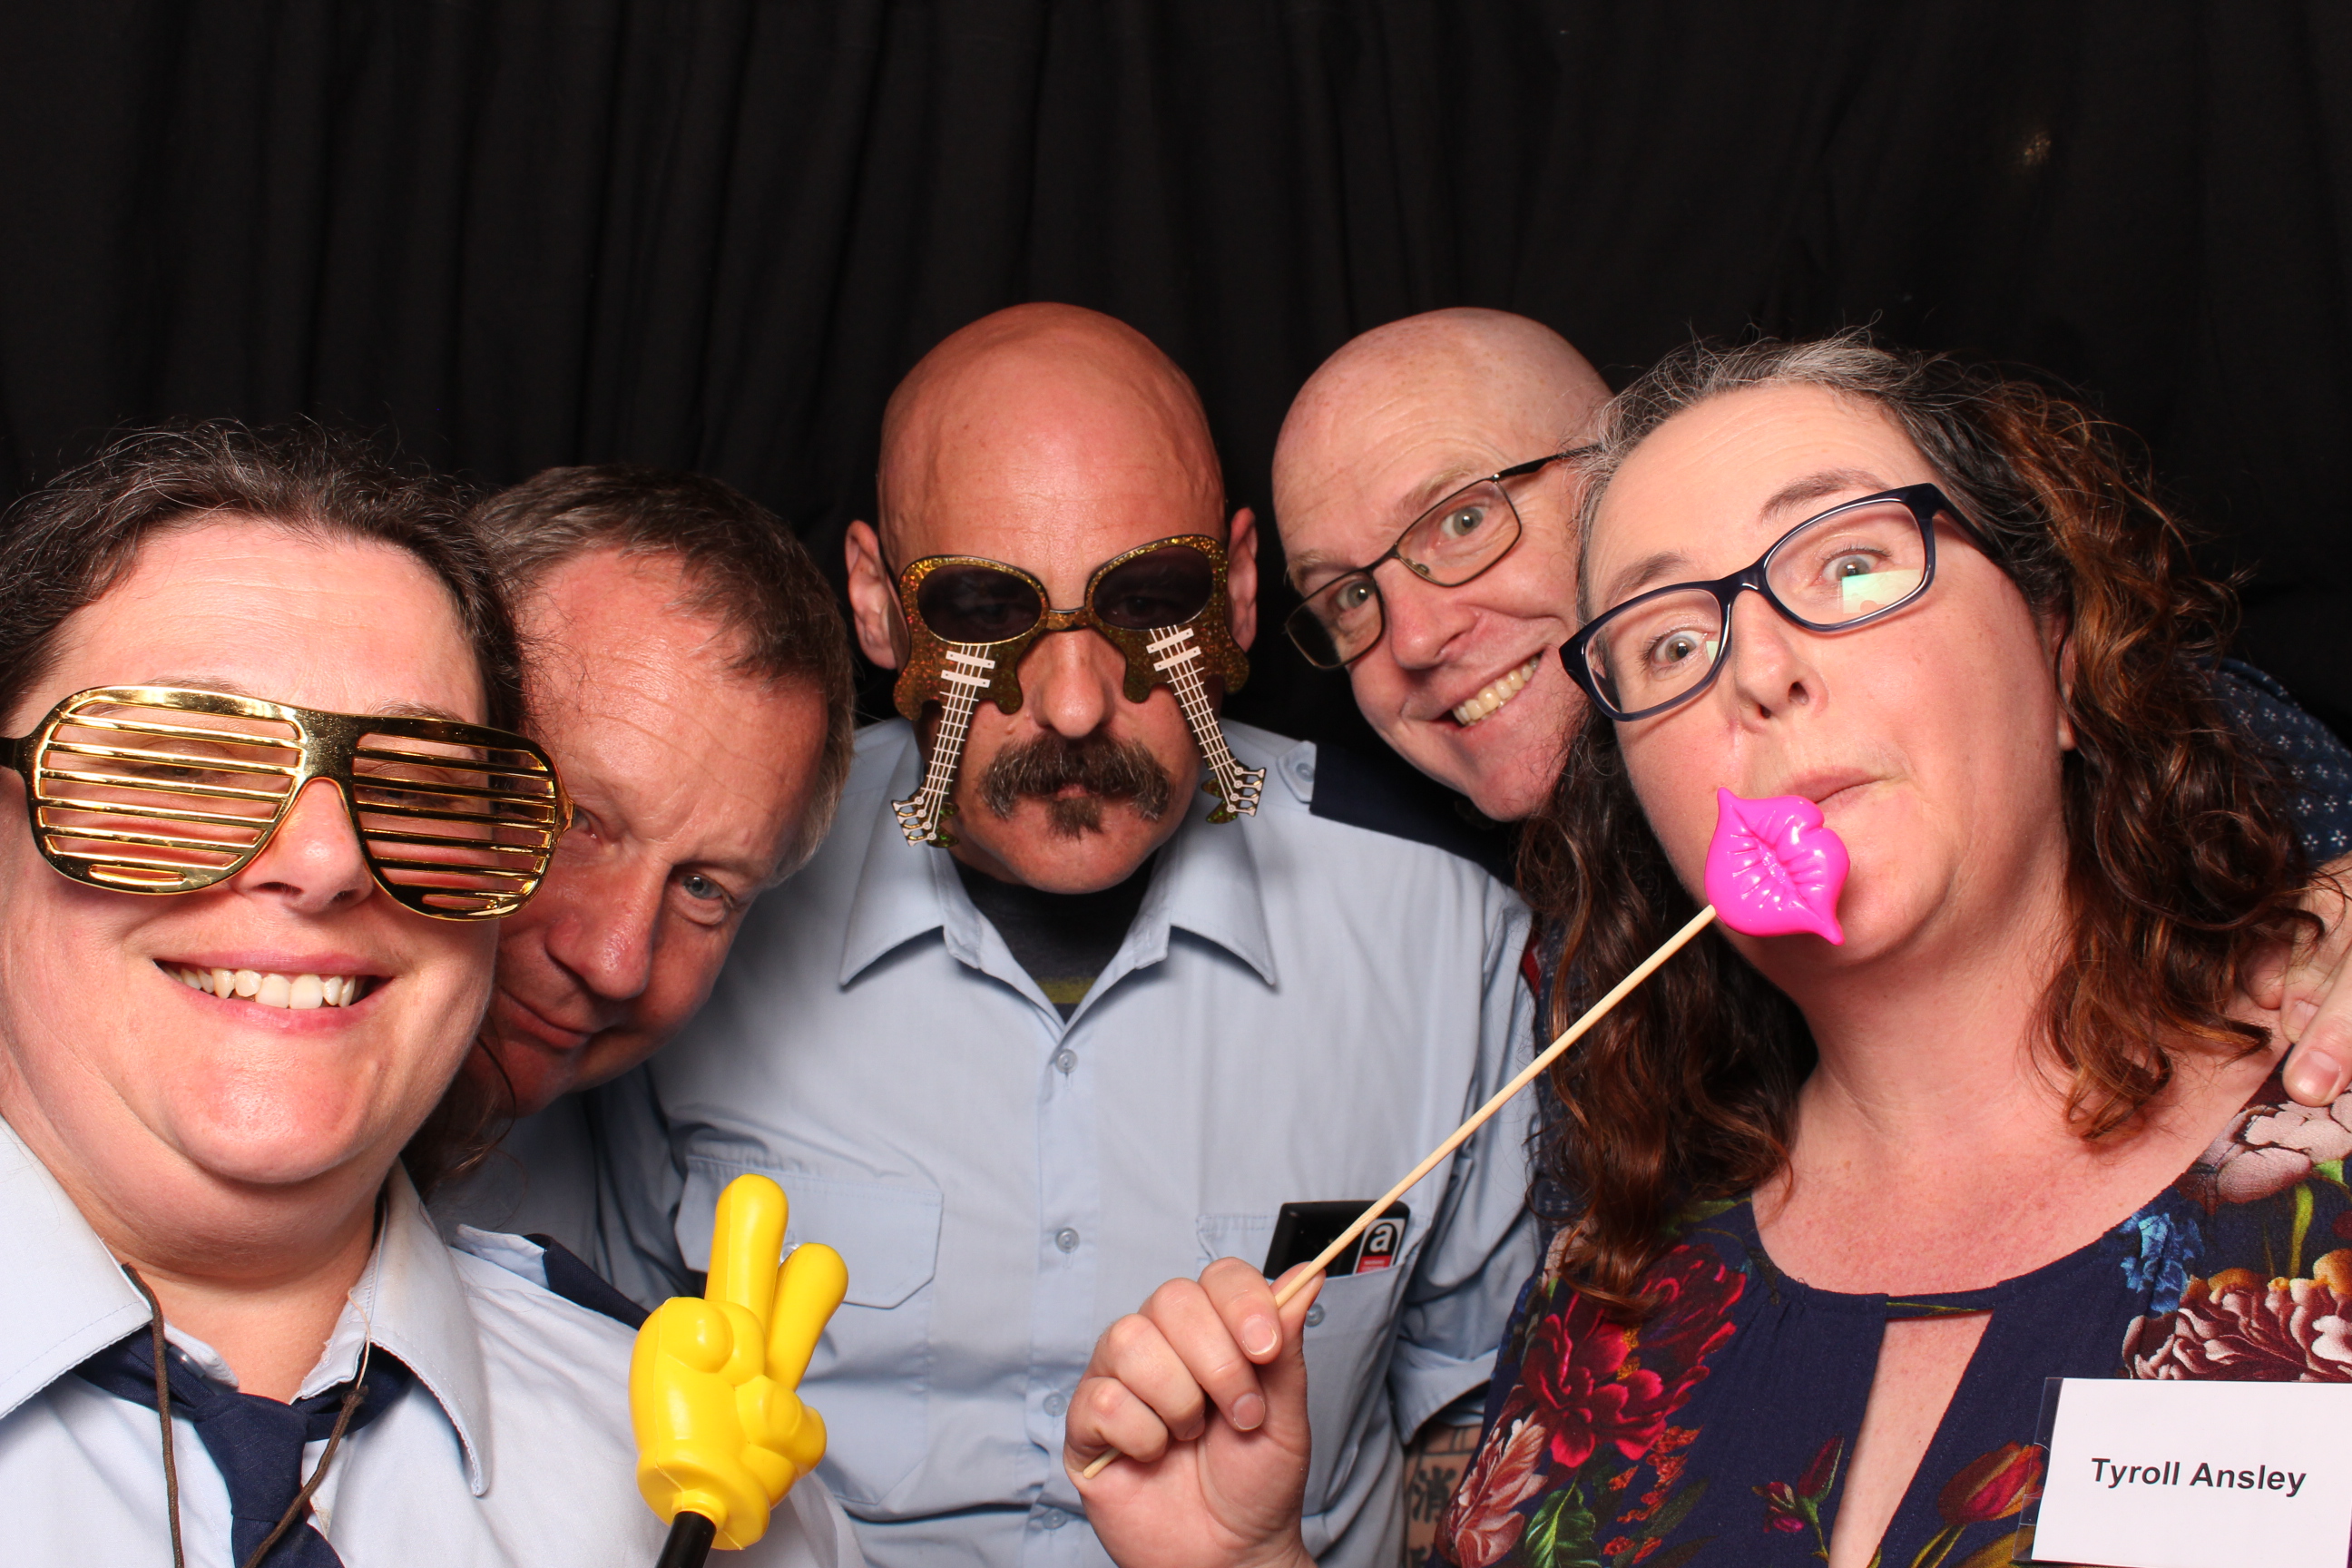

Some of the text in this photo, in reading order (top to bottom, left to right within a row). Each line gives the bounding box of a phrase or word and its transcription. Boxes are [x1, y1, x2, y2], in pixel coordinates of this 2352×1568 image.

[1370, 1225, 1393, 1252] a
[2092, 1457, 2307, 1498] Tyroll Ansley
